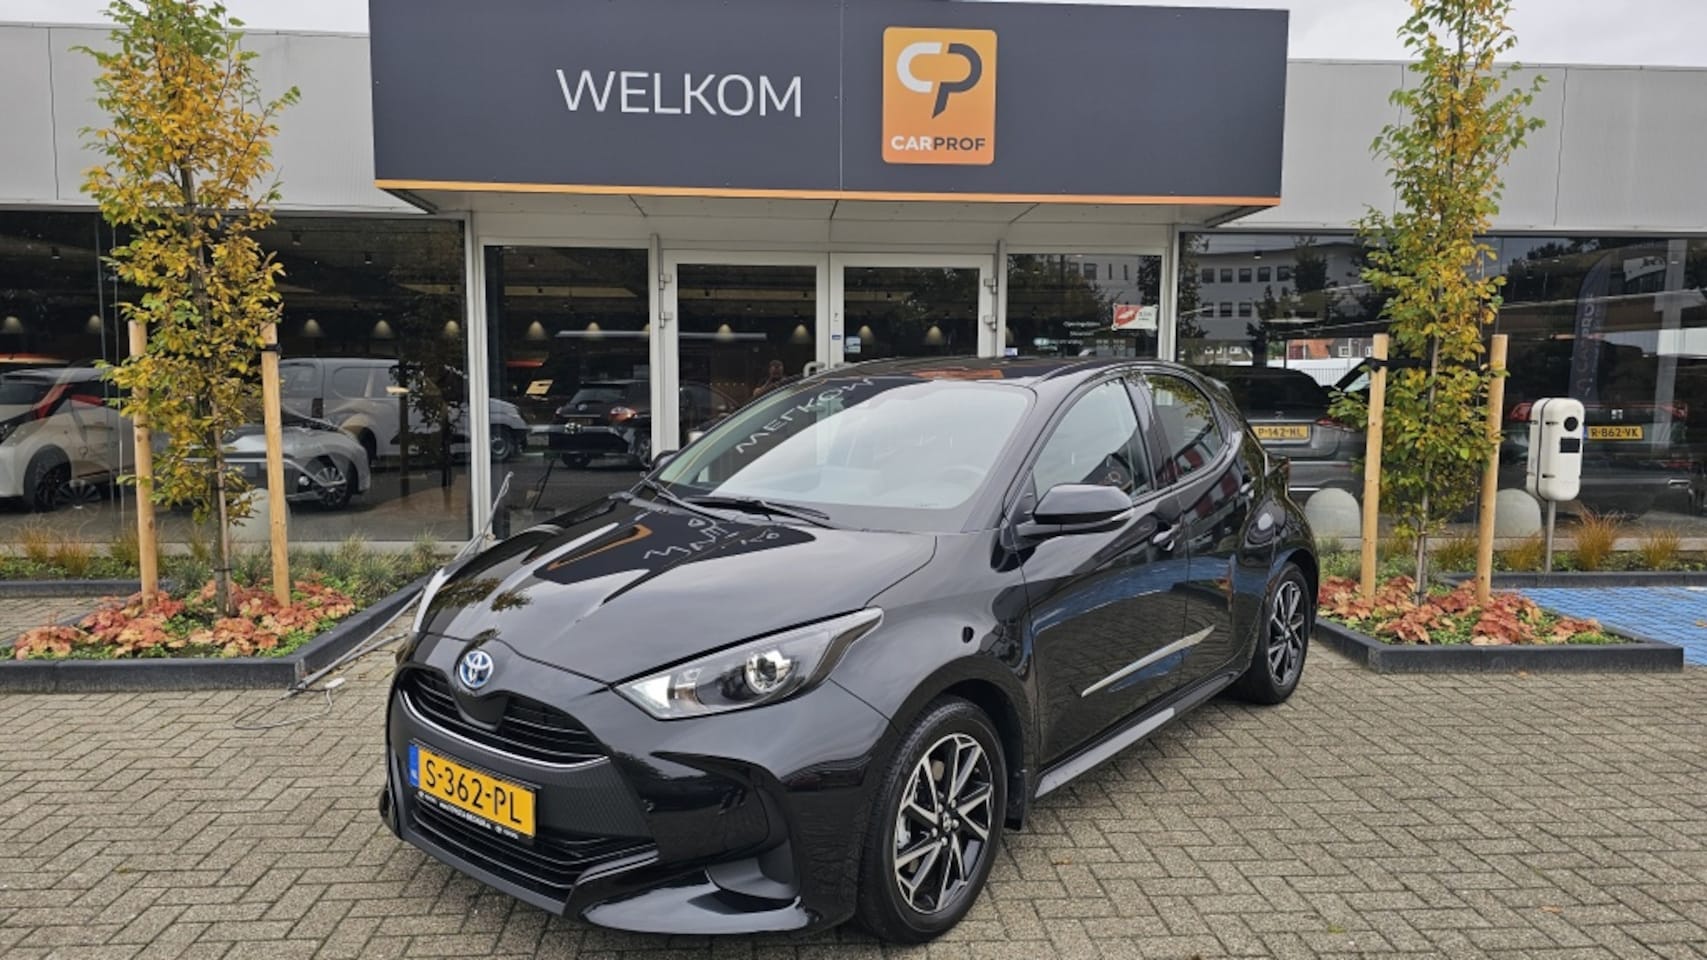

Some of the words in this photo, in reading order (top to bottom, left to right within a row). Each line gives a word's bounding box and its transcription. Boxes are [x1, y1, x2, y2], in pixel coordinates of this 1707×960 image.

[556, 69, 802, 117] WELKOM
[891, 135, 986, 151] CARPROF
[1591, 427, 1638, 438] R-862-VK
[426, 759, 522, 824] S-362-PL
